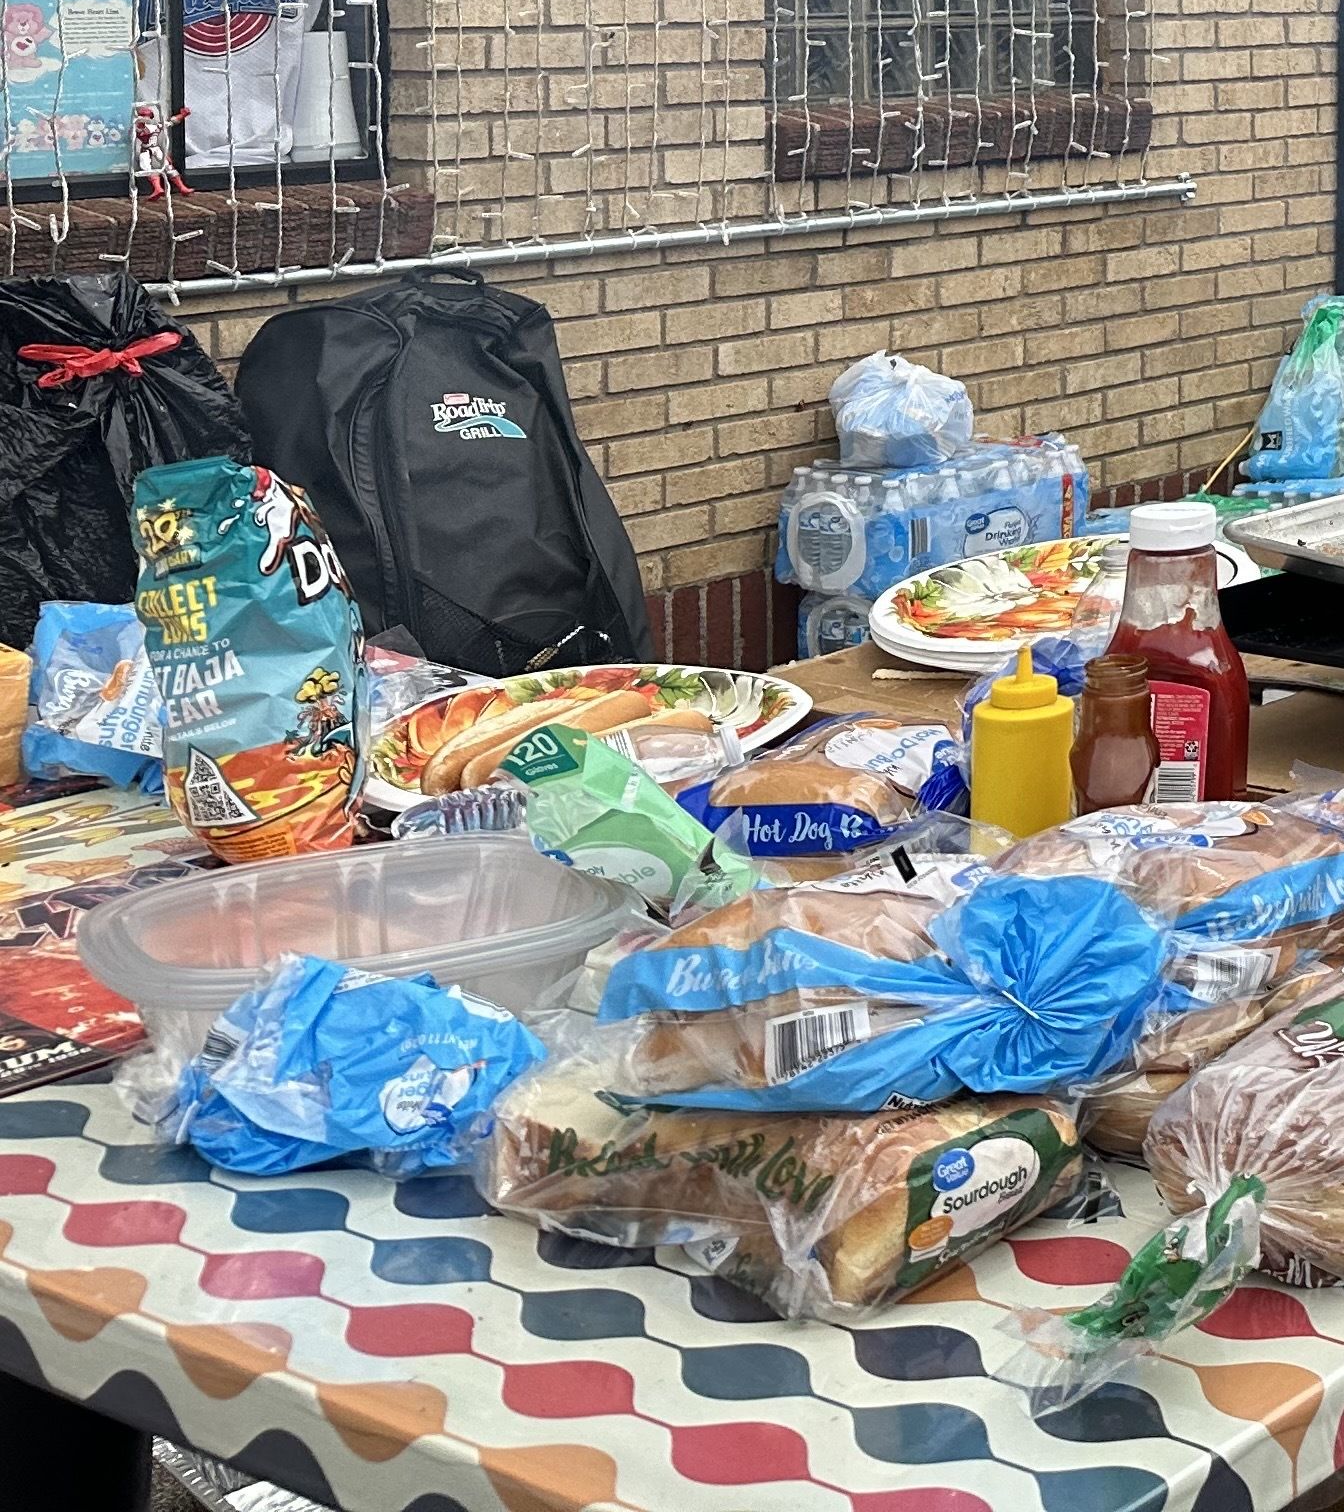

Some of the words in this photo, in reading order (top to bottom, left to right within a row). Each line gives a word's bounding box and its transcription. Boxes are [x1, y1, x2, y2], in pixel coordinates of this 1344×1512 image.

[459, 427, 502, 441] GRILL
[173, 642, 209, 659] CHANCE
[214, 638, 231, 652] TO
[173, 649, 246, 695] BAJA
[168, 689, 225, 729] EAR
[506, 732, 559, 768] 120
[742, 813, 788, 844] Hot
[788, 811, 833, 851] Dog
[936, 1155, 969, 1178] Great
[945, 1168, 970, 1184] Value
[942, 1165, 1028, 1215] Sourdough
